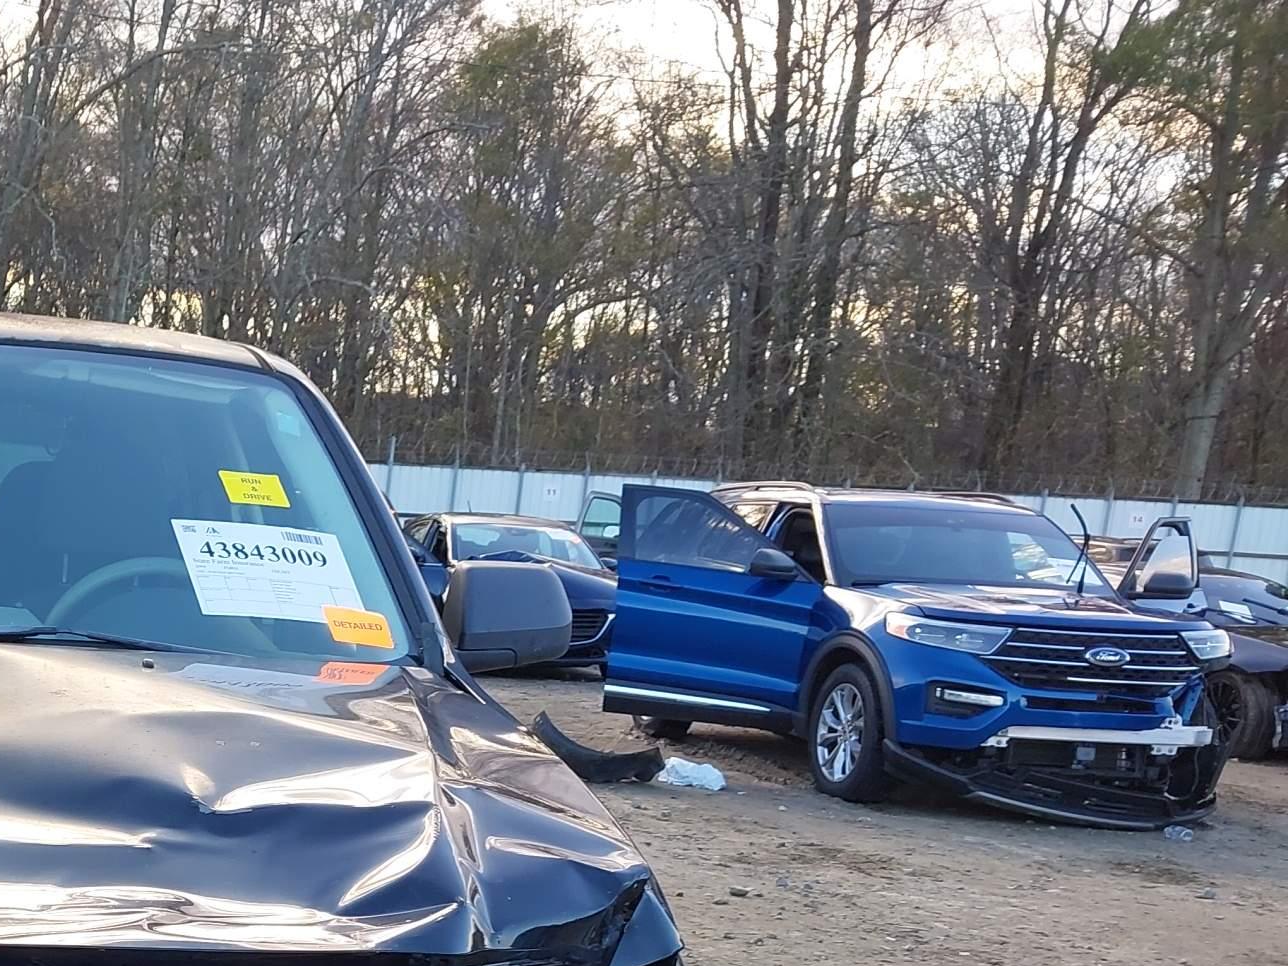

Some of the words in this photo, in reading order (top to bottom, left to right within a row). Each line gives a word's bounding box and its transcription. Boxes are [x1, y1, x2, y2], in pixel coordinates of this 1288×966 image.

[241, 477, 261, 485] RUN
[243, 493, 272, 501] DRIVE
[200, 541, 327, 567] 43843009
[333, 618, 384, 632] DETAILED
